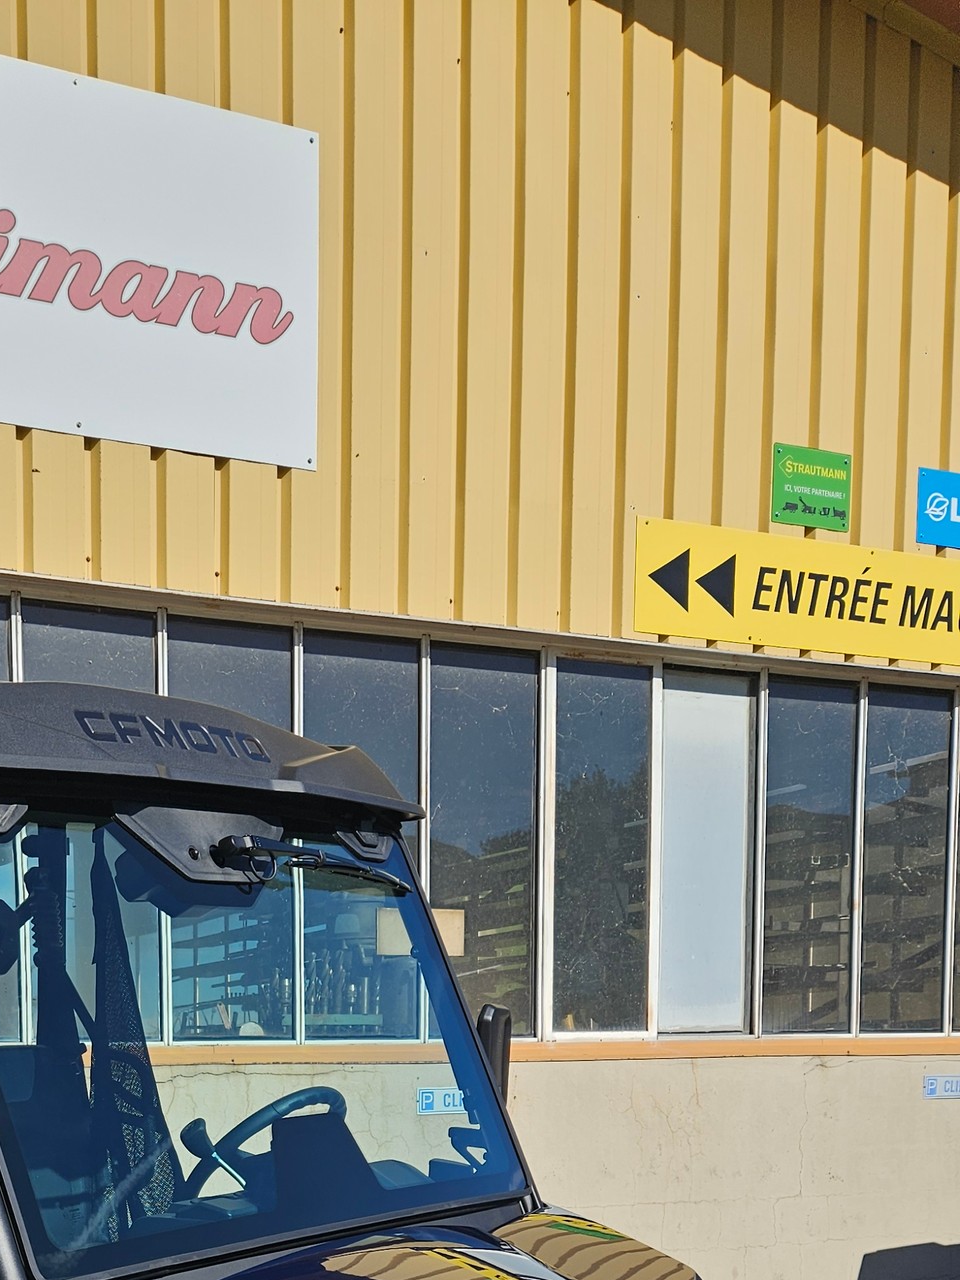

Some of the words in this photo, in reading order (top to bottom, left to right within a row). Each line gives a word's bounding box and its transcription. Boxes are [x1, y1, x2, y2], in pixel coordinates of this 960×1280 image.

[785, 460, 847, 480] STRAUTMANN
[784, 484, 793, 493] ICI,
[793, 485, 811, 495] VOTRE
[811, 488, 843, 499] PARTENAIRE
[752, 566, 893, 625] ENTRÉE
[898, 585, 960, 632] MA
[74, 710, 271, 763] CFMOTO
